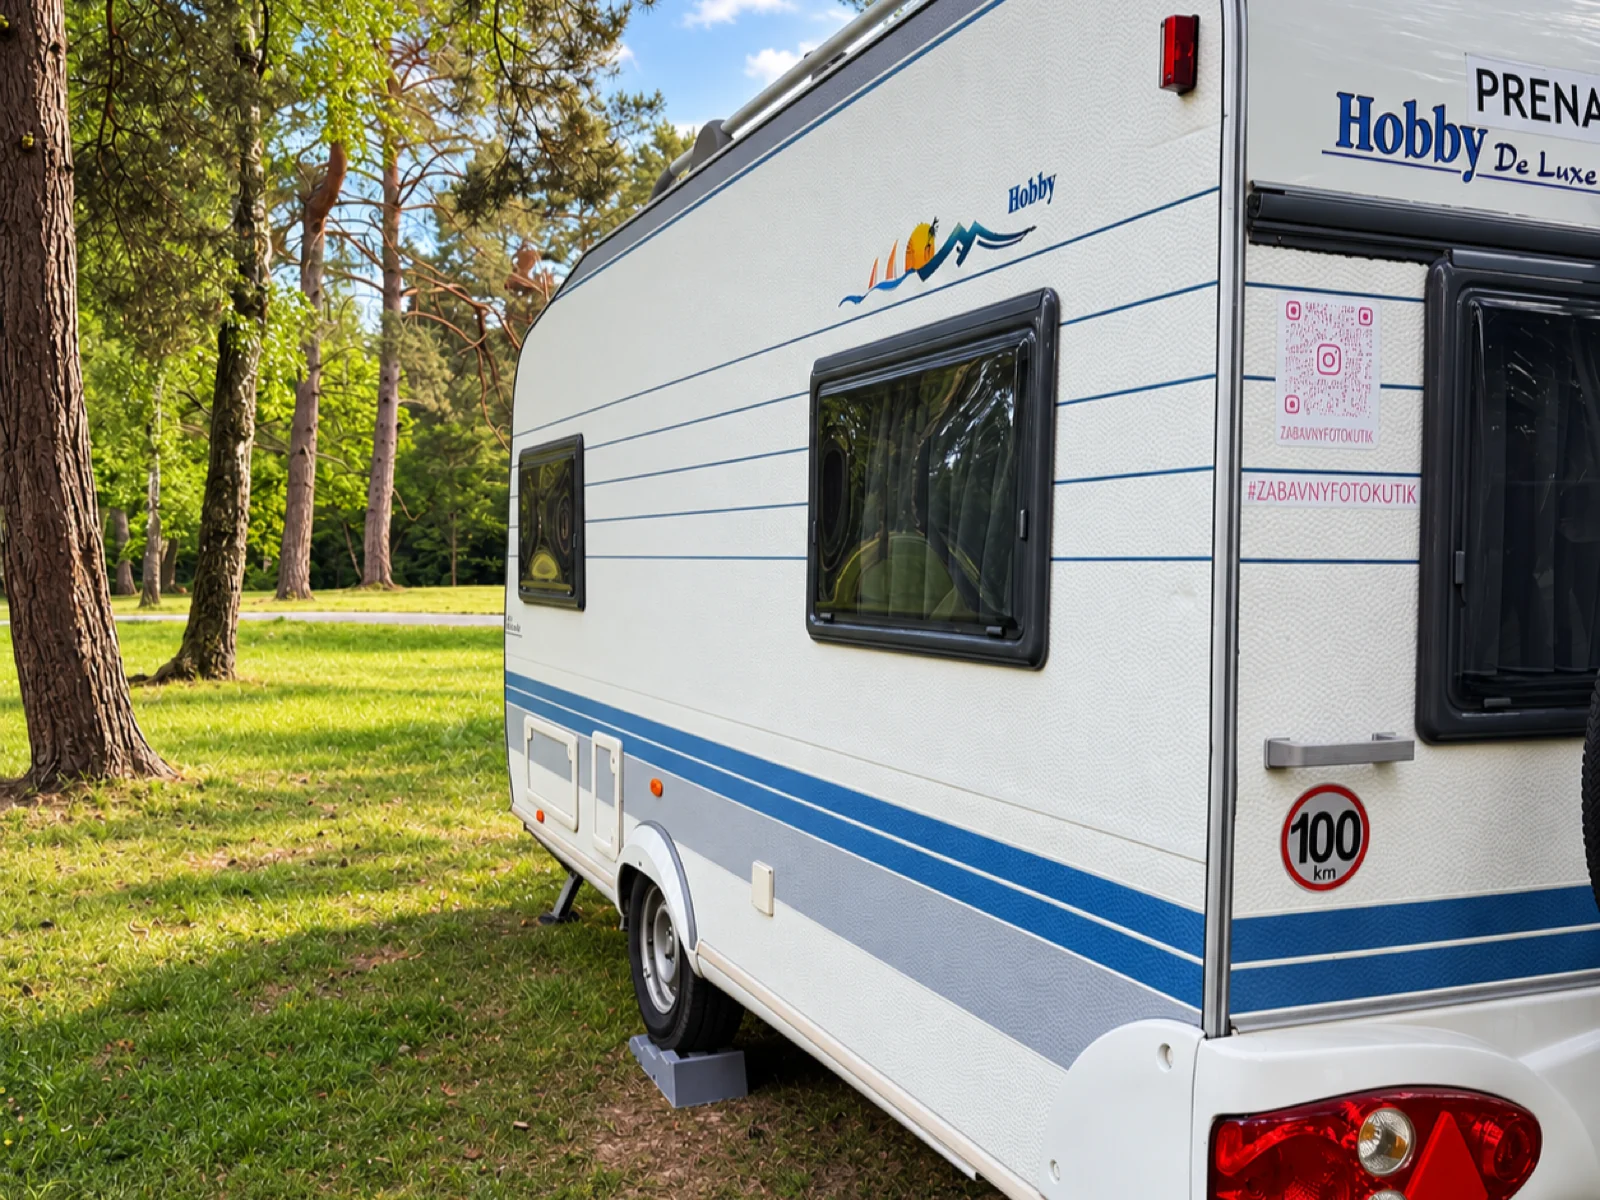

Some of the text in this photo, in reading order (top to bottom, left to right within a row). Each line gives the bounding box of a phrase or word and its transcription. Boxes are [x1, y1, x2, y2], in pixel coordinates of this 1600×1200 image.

[1475, 67, 1600, 128] PRENA
[1336, 91, 1488, 182] Hobby
[1494, 142, 1597, 186] De Luxe
[1008, 171, 1057, 214] Hobby
[1280, 425, 1374, 443] ZABAVNYFOTOKUTIK
[1247, 480, 1417, 504] #ZABAVNYFOTOKUTIK
[1290, 809, 1361, 864] 100
[1313, 865, 1336, 881] km
